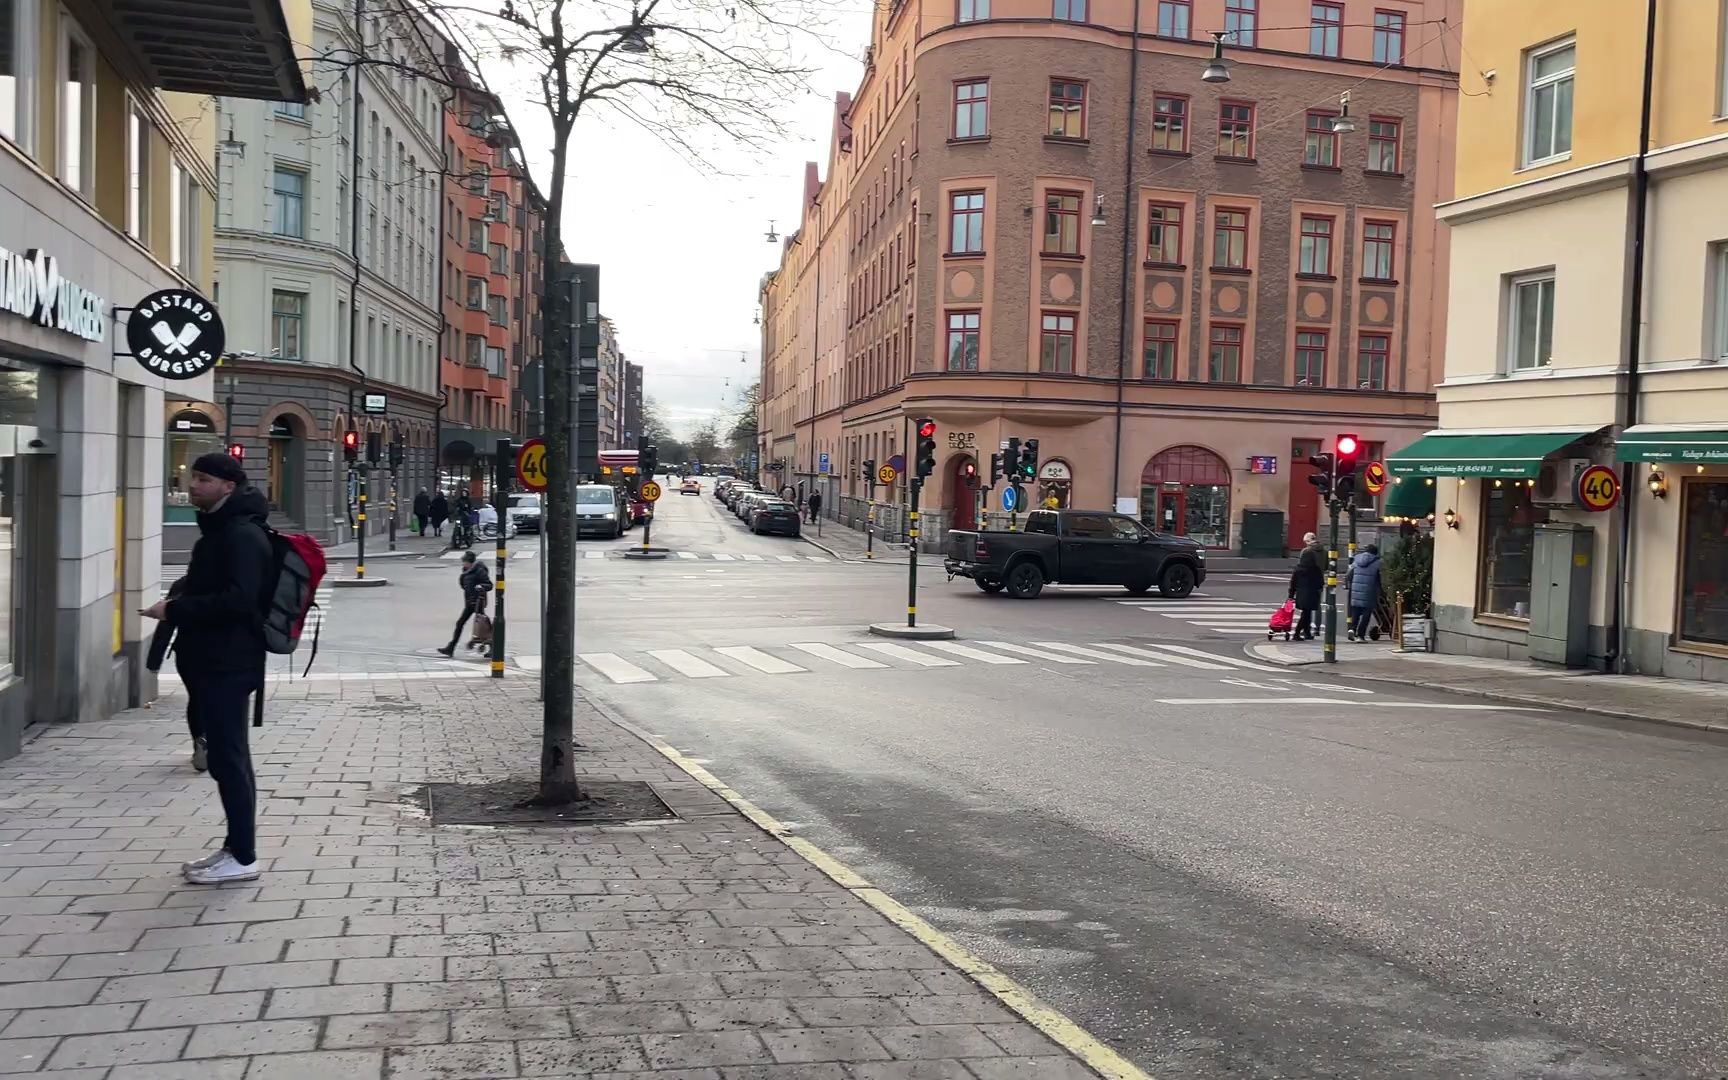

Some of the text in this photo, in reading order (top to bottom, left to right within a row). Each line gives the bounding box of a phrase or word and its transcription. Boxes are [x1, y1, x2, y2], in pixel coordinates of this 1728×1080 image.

[139, 294, 213, 323] BASTARD
[139, 347, 212, 374] BURGERS
[881, 468, 895, 479] 30
[643, 486, 658, 497] 30
[1586, 477, 1613, 499] 40
